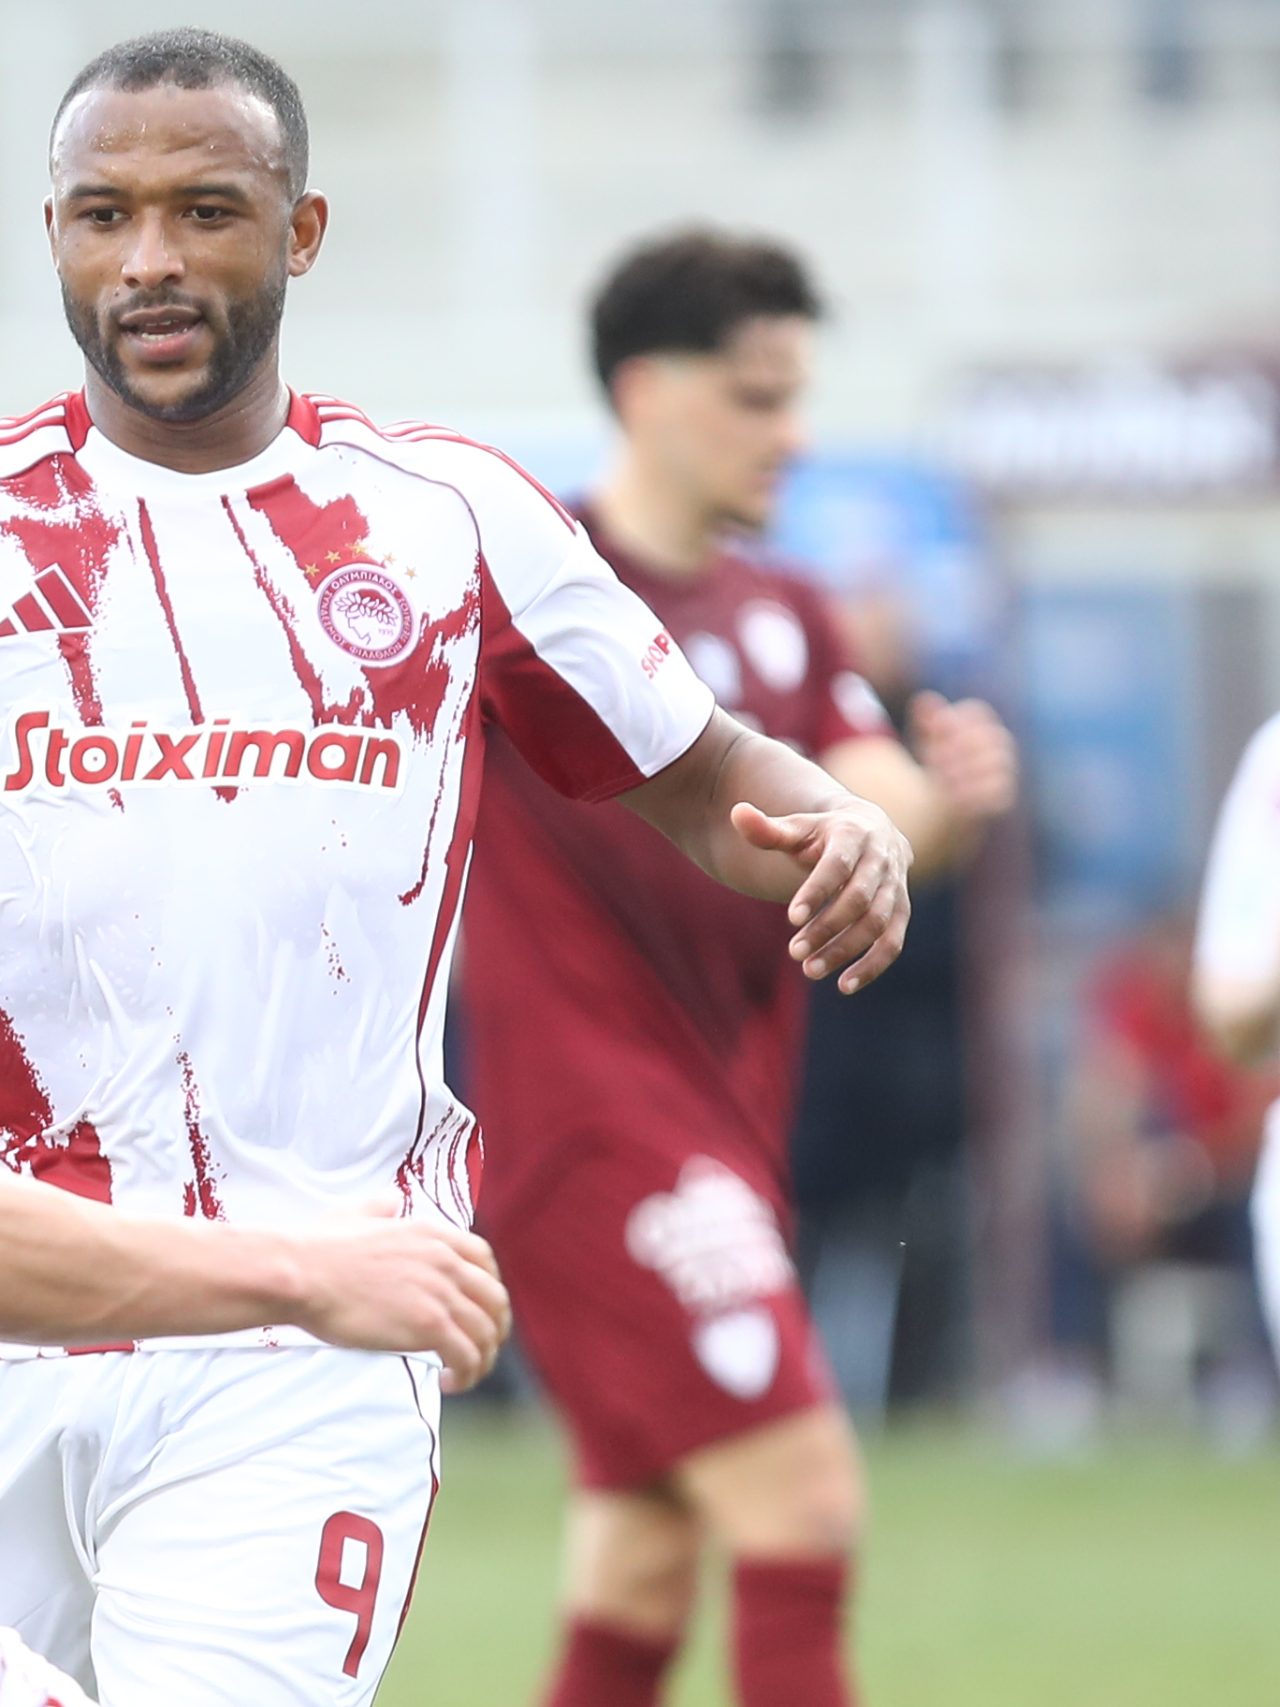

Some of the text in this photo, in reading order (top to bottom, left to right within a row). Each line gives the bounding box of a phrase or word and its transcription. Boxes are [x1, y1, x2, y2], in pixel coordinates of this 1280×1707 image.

[331, 571, 398, 594] ΟΛΥΜΠΙΑΚΟΣ
[3, 711, 402, 791] Stoiximan
[315, 1511, 384, 1679] 9
